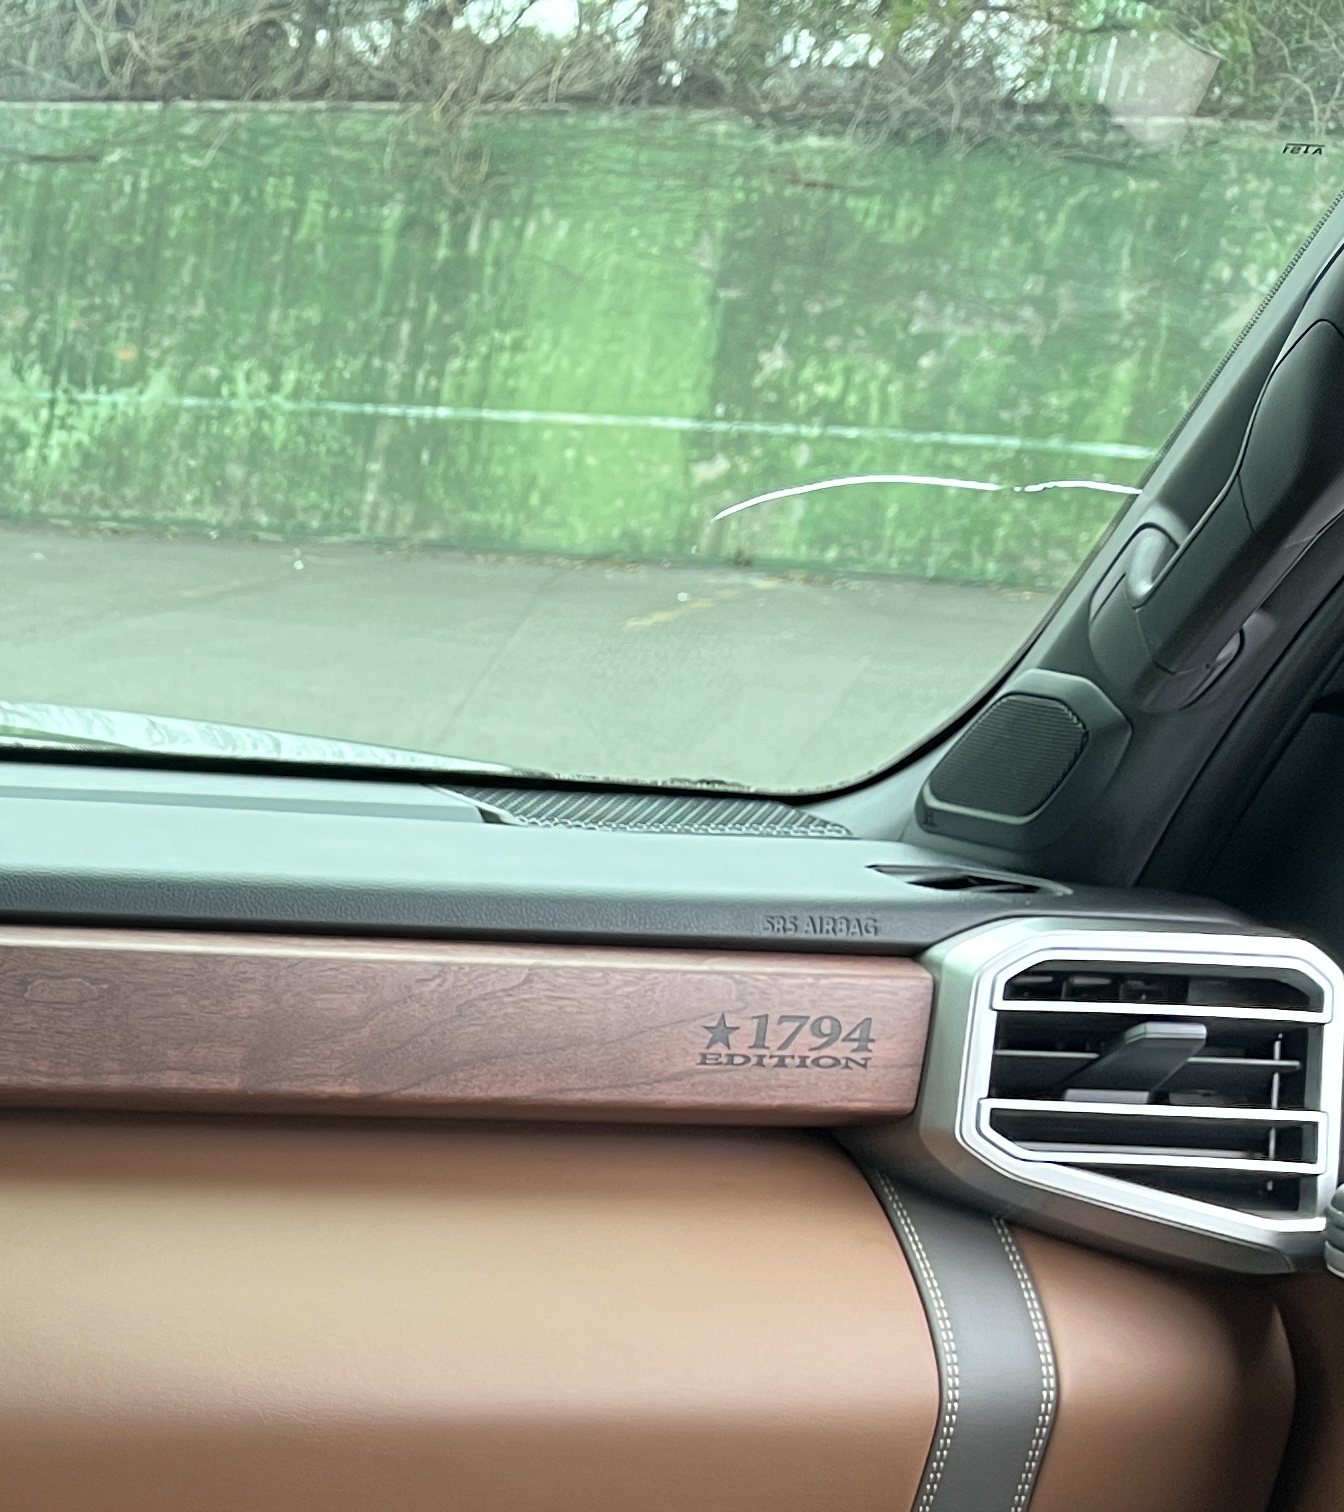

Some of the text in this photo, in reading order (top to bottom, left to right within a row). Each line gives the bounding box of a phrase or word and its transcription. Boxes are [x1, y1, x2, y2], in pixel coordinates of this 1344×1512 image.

[763, 914, 879, 937] SRS AIRBAG
[747, 1013, 876, 1053] 1794
[696, 1052, 873, 1070] EDITION
